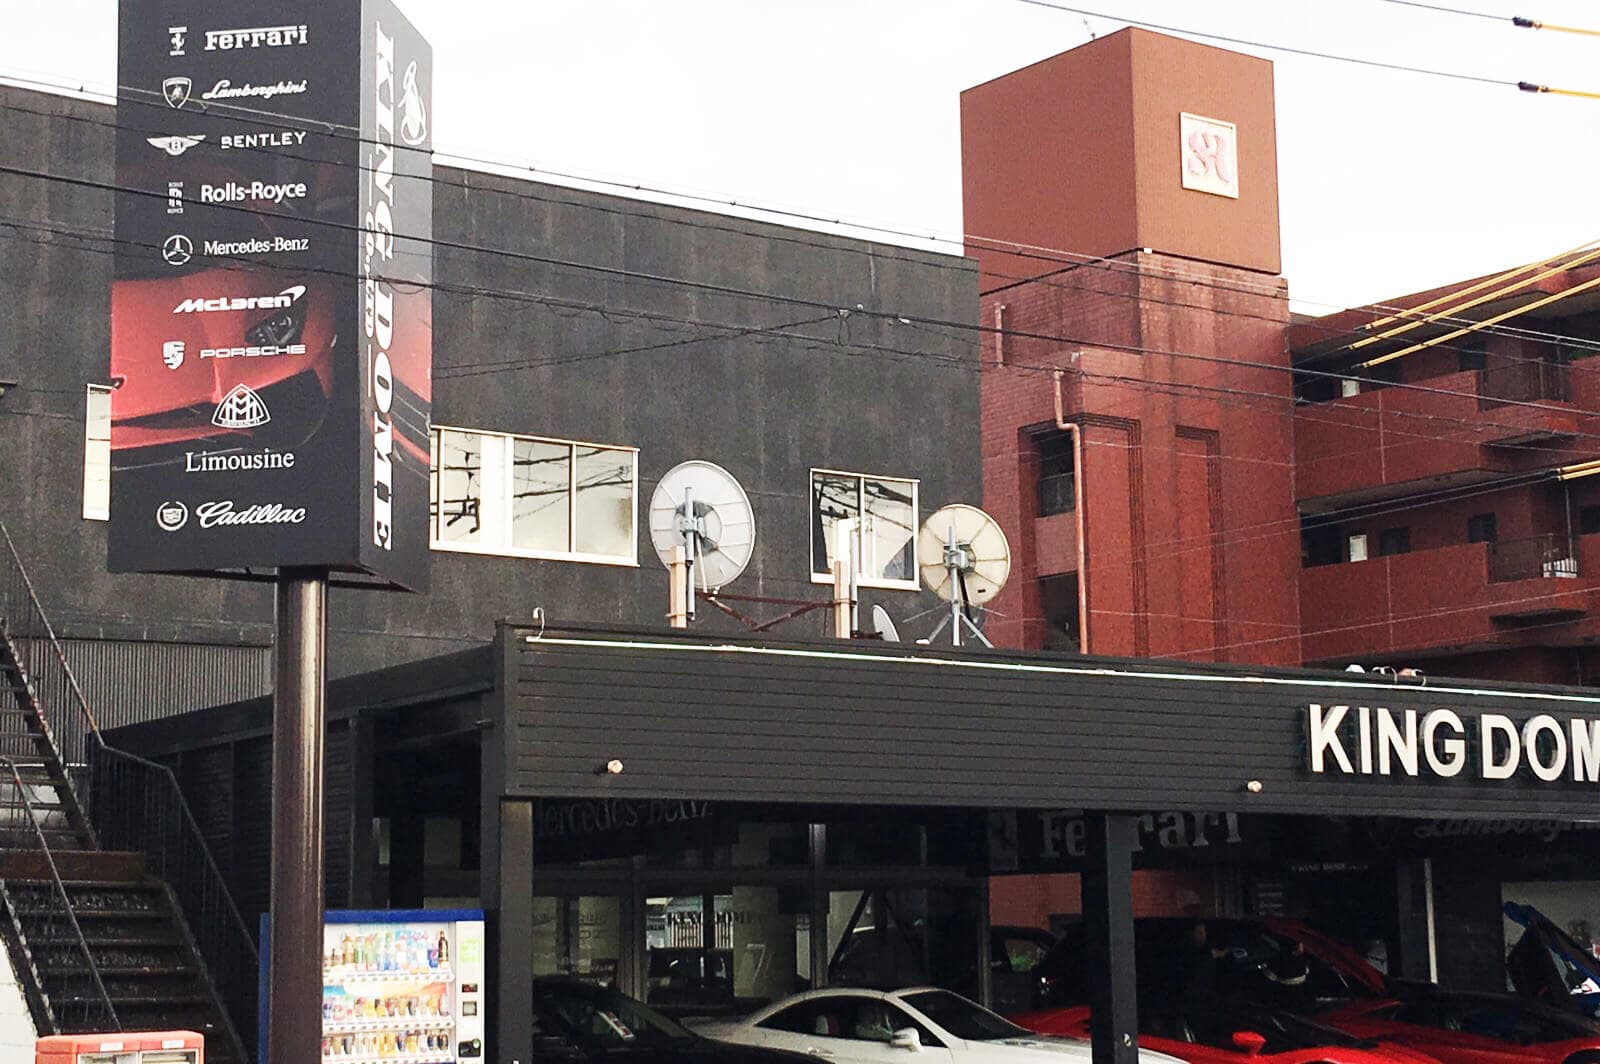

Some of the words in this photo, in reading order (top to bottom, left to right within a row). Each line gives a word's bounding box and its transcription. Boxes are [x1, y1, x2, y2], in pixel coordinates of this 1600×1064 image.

[204, 25, 308, 51] Ferrari
[202, 80, 308, 100] Lamborghini
[221, 132, 306, 149] BENTLEY
[375, 20, 394, 262] KING
[201, 181, 307, 203] Rolls-Royce
[203, 236, 309, 256] Mercedes-Benz
[173, 286, 306, 313] McLaren
[200, 344, 306, 359] PORSCHE
[374, 281, 394, 551] DOME
[185, 448, 295, 472] Limousine
[196, 501, 306, 529] Cadillac
[1309, 703, 1466, 777] KING
